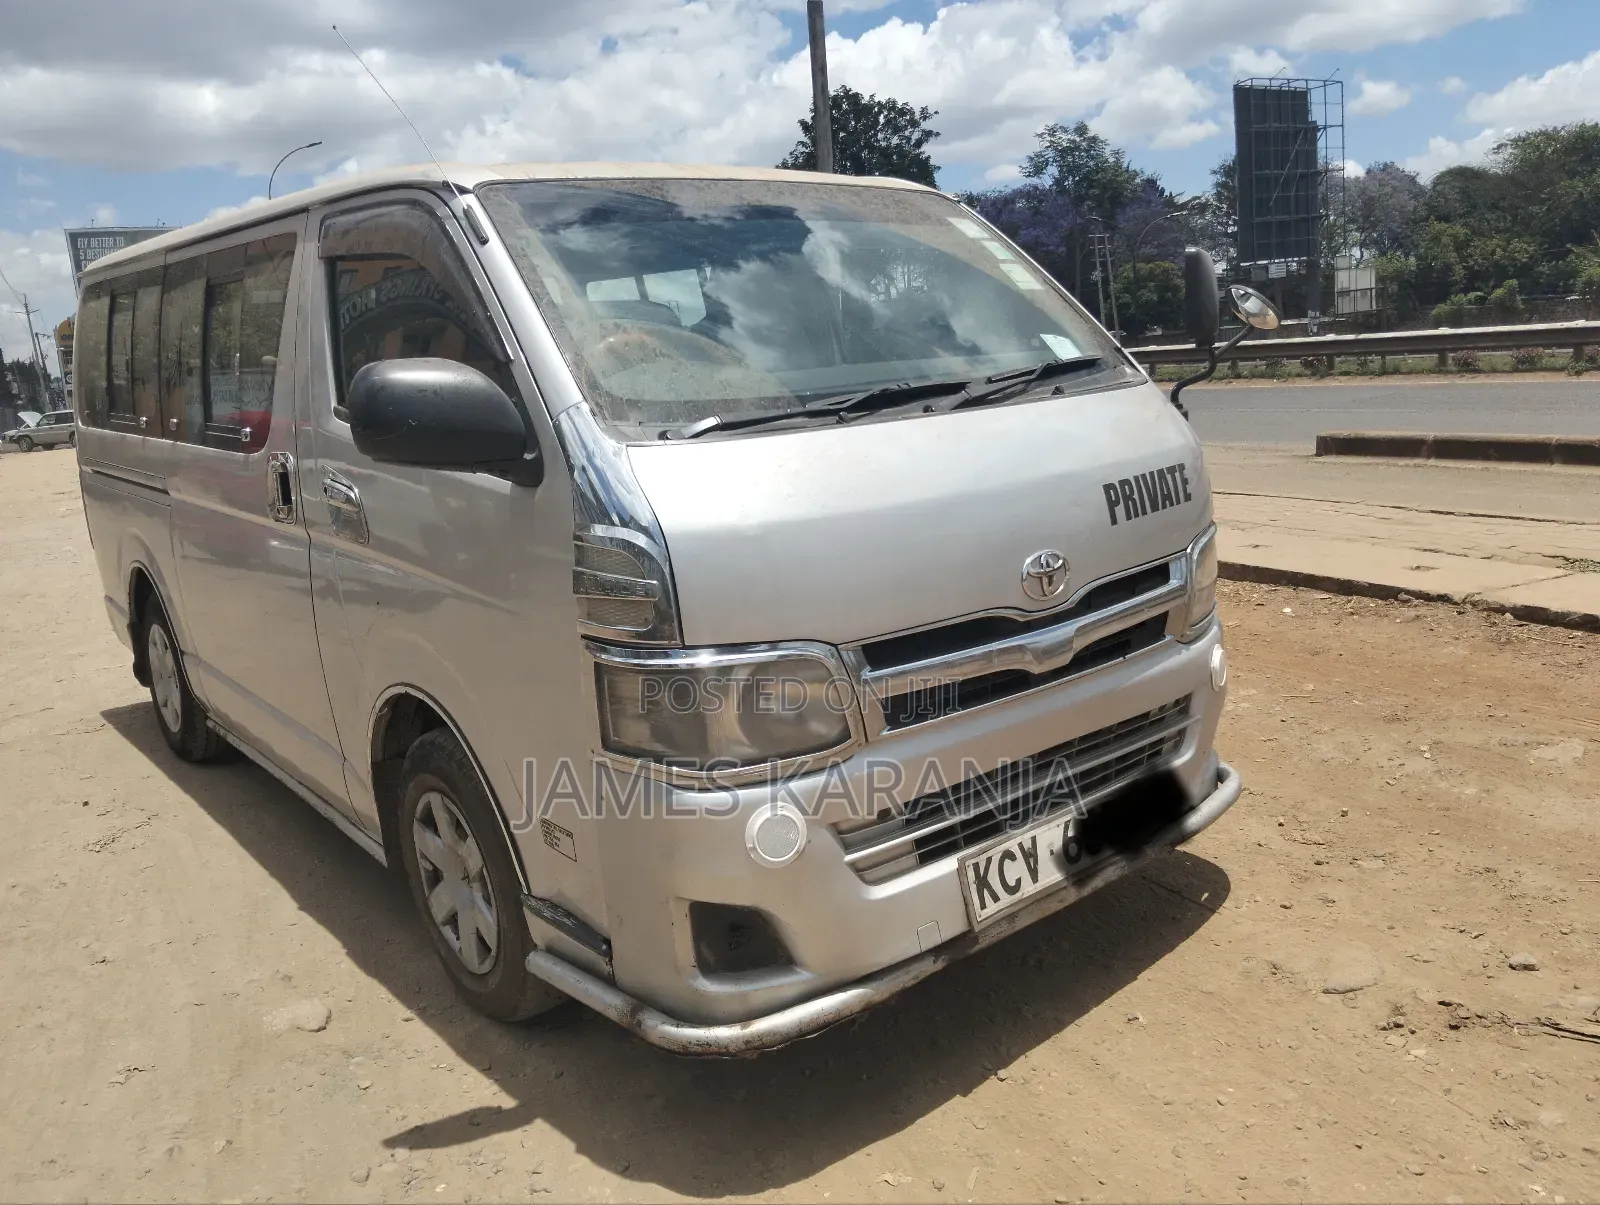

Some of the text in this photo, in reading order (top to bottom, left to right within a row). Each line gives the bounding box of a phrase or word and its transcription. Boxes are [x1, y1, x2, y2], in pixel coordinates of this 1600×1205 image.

[77, 236, 125, 249] FLY BETTER TO
[80, 249, 85, 260] 5
[1102, 462, 1192, 527] PRIVATE
[972, 834, 1039, 911] KCV
